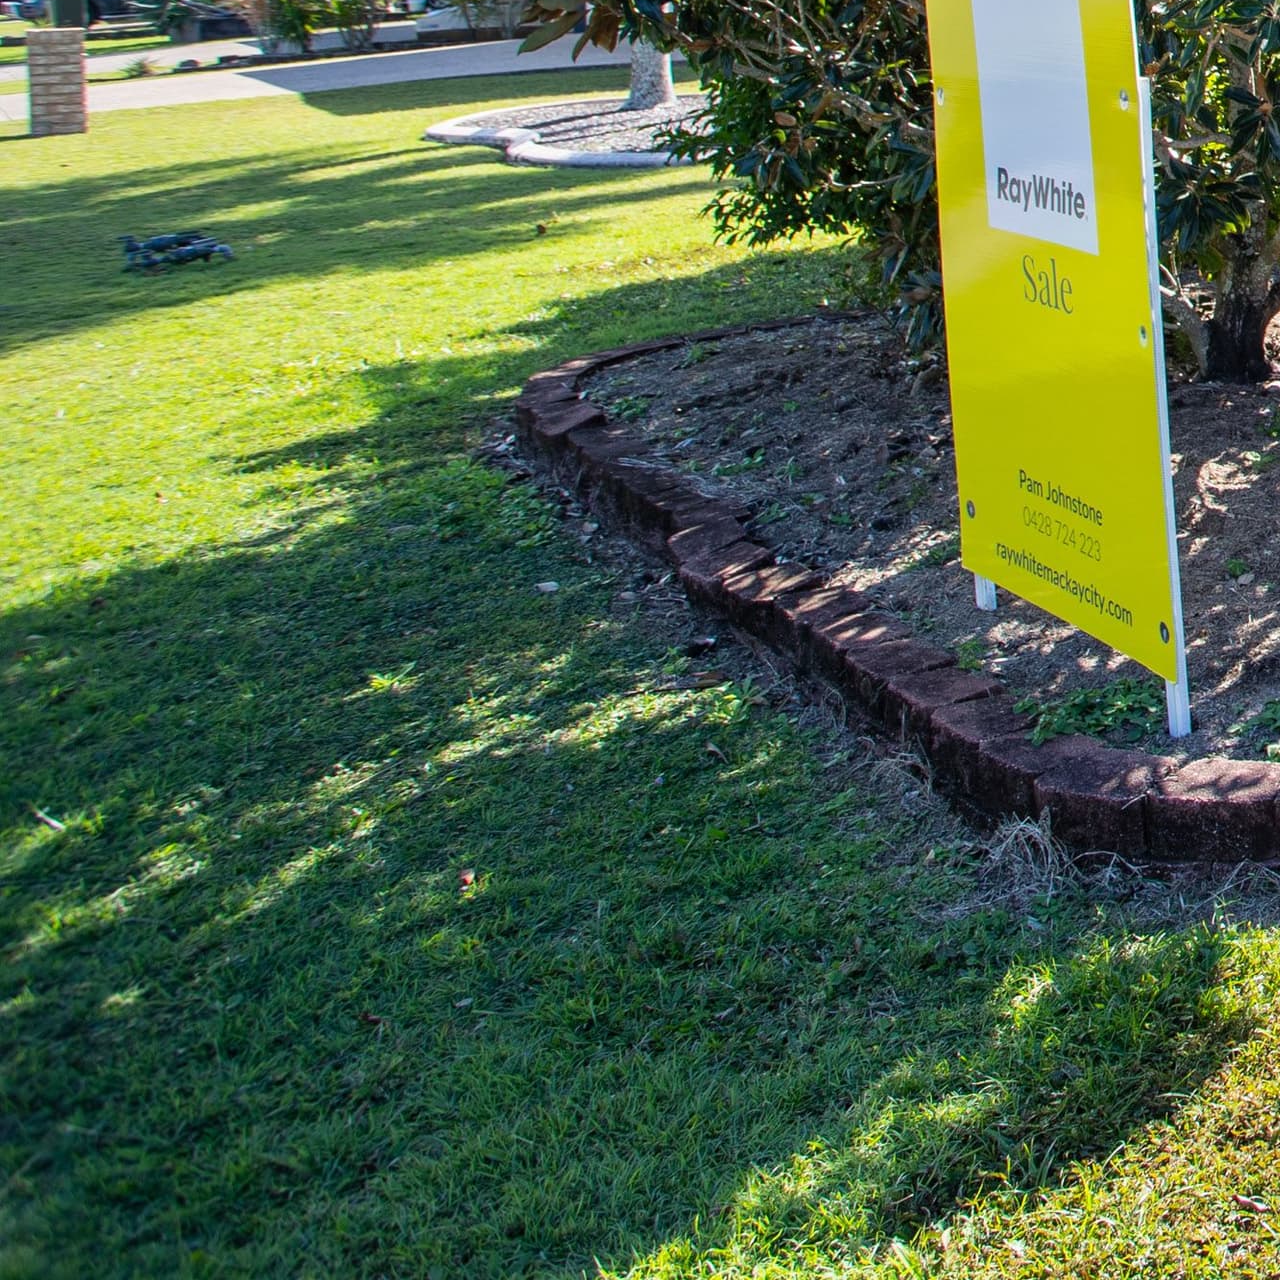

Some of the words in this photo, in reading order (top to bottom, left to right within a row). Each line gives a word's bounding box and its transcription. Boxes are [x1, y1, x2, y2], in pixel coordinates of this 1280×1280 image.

[1022, 254, 1074, 314] Sale
[1019, 468, 1043, 497] Pam
[1046, 481, 1103, 526] Johnstone
[1023, 506, 1052, 536] 0428
[1055, 520, 1077, 548] 724
[1079, 532, 1102, 562] 223
[995, 542, 1134, 627] raywhitemackaycity.com
